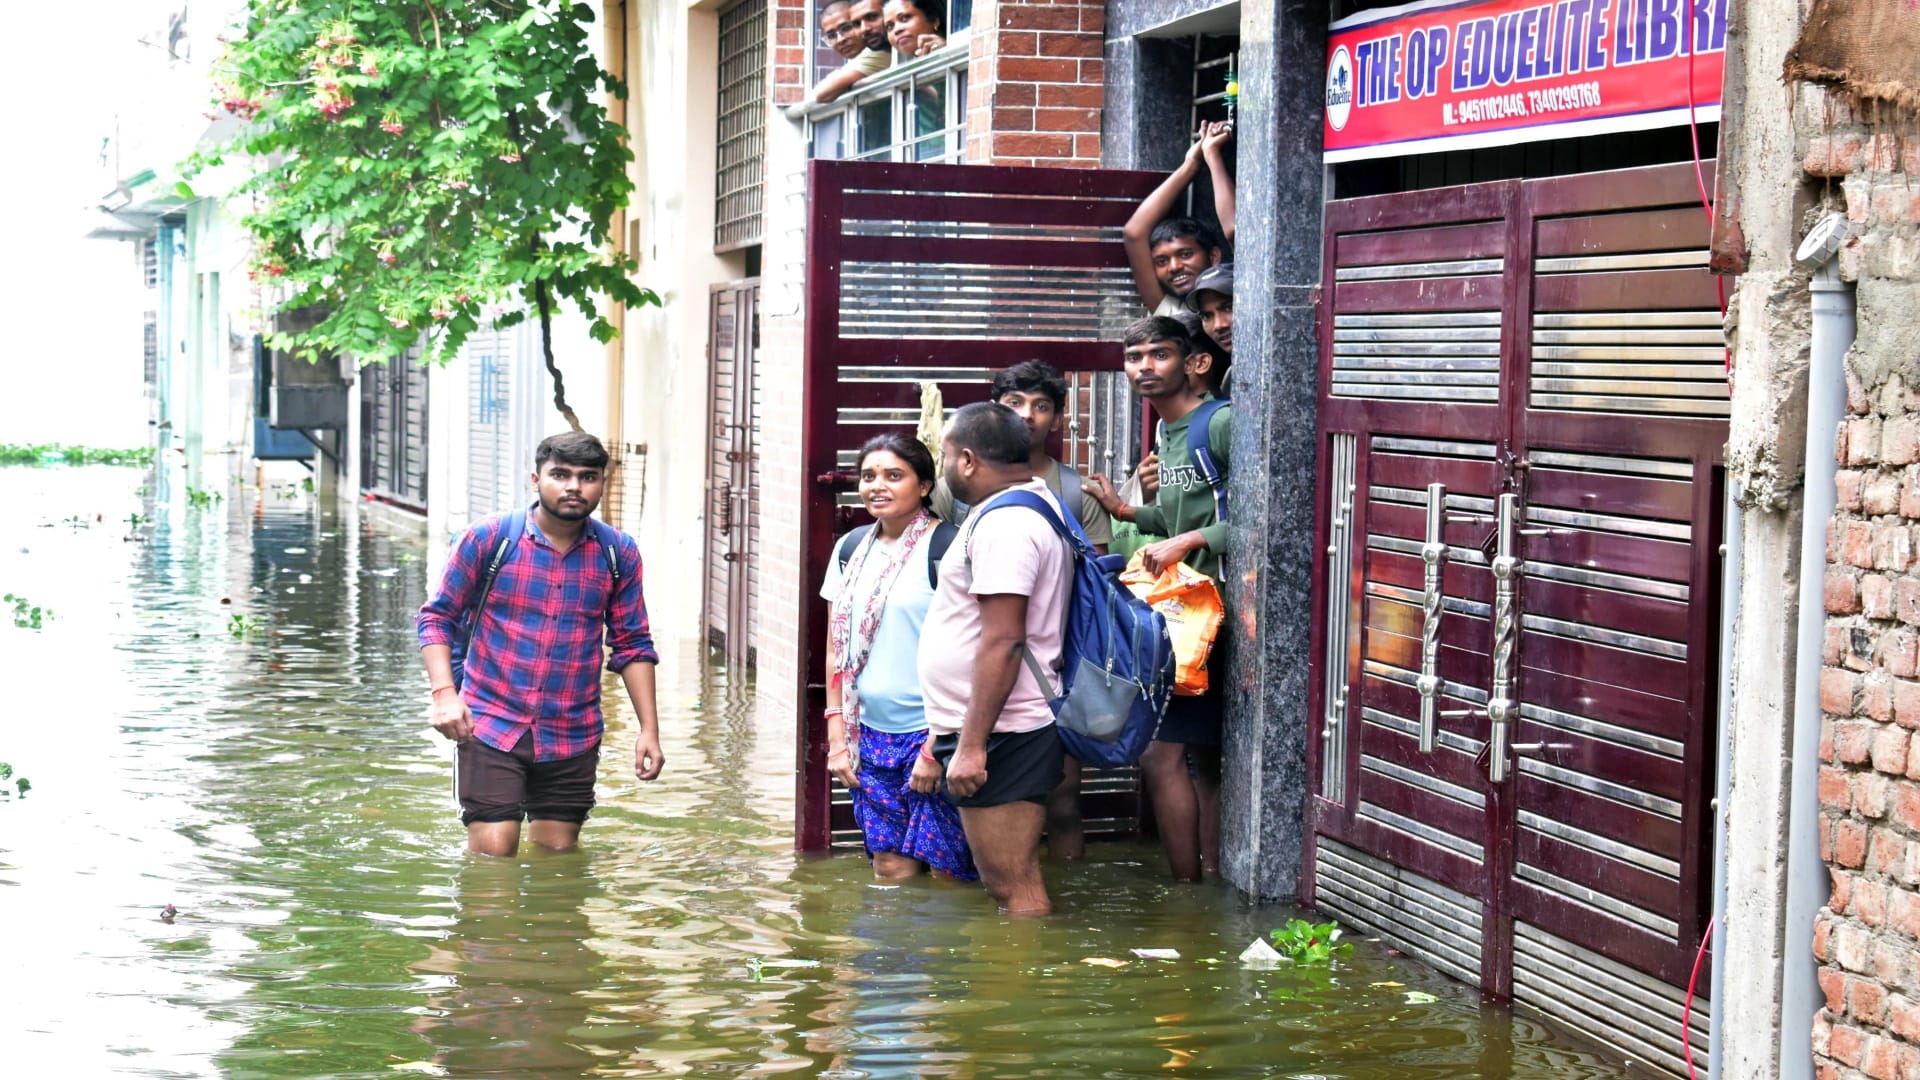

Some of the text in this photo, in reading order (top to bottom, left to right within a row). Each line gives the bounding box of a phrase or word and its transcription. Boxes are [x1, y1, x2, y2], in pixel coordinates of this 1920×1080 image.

[1355, 33, 1403, 107] THE
[1405, 25, 1450, 100] OP
[1451, 0, 1610, 92] EDUELITE
[1459, 92, 1530, 124] 9451102446,
[1528, 81, 1602, 115] 7340299768
